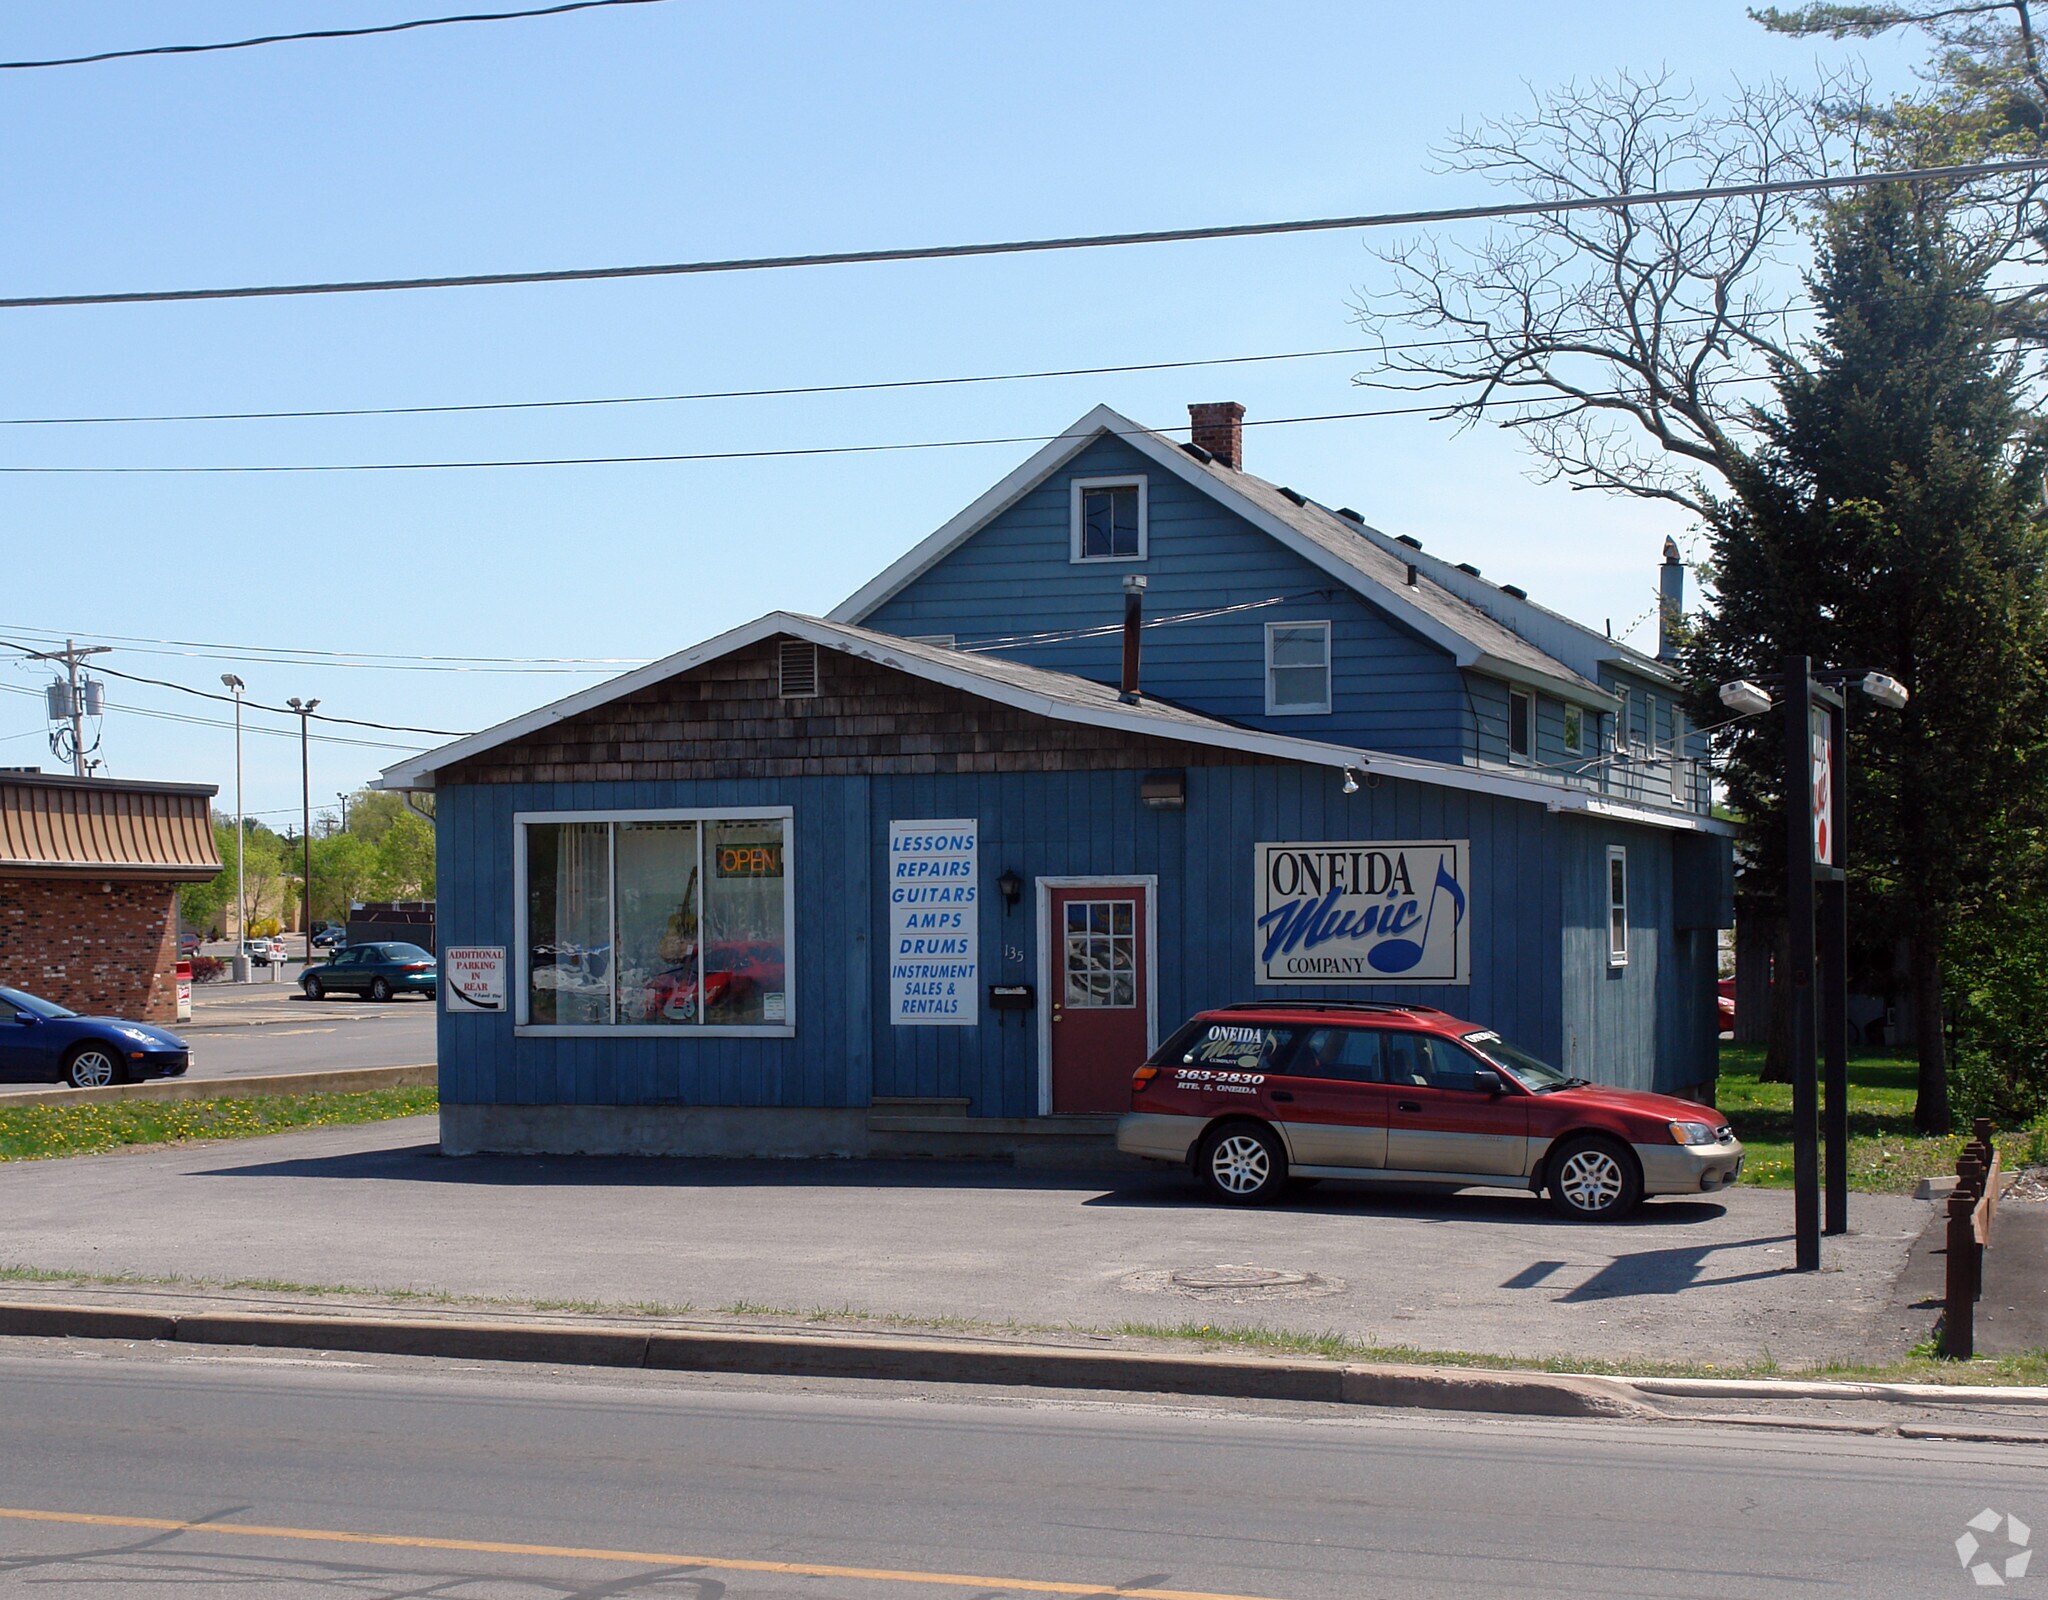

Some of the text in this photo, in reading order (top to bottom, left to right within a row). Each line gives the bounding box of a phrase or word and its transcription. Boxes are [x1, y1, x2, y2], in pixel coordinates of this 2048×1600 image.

[892, 835, 975, 851] LESSONS
[722, 848, 776, 872] OPEN
[895, 861, 971, 877] REPAIRS
[1272, 851, 1415, 896] ONEIDA
[891, 887, 976, 903] GUITARS
[906, 913, 962, 928] AMPS
[1257, 886, 1423, 965] Music
[899, 939, 968, 954] DRUMS
[1004, 944, 1024, 963] 135
[448, 950, 504, 960] ADDITIONAL
[456, 961, 496, 970] PARKING
[892, 964, 975, 979] INSTRUMENT
[1287, 957, 1365, 974] COMPANY
[471, 972, 481, 981] IN
[463, 982, 488, 991] REAR
[904, 982, 956, 996] SALES &
[901, 999, 958, 1014] RENTALS
[1208, 1025, 1262, 1043] ONEIDA
[1200, 1038, 1262, 1061] Music
[1174, 1069, 1265, 1085] 363-2830
[1177, 1082, 1257, 1094] RTE. 5, ONEIDA
